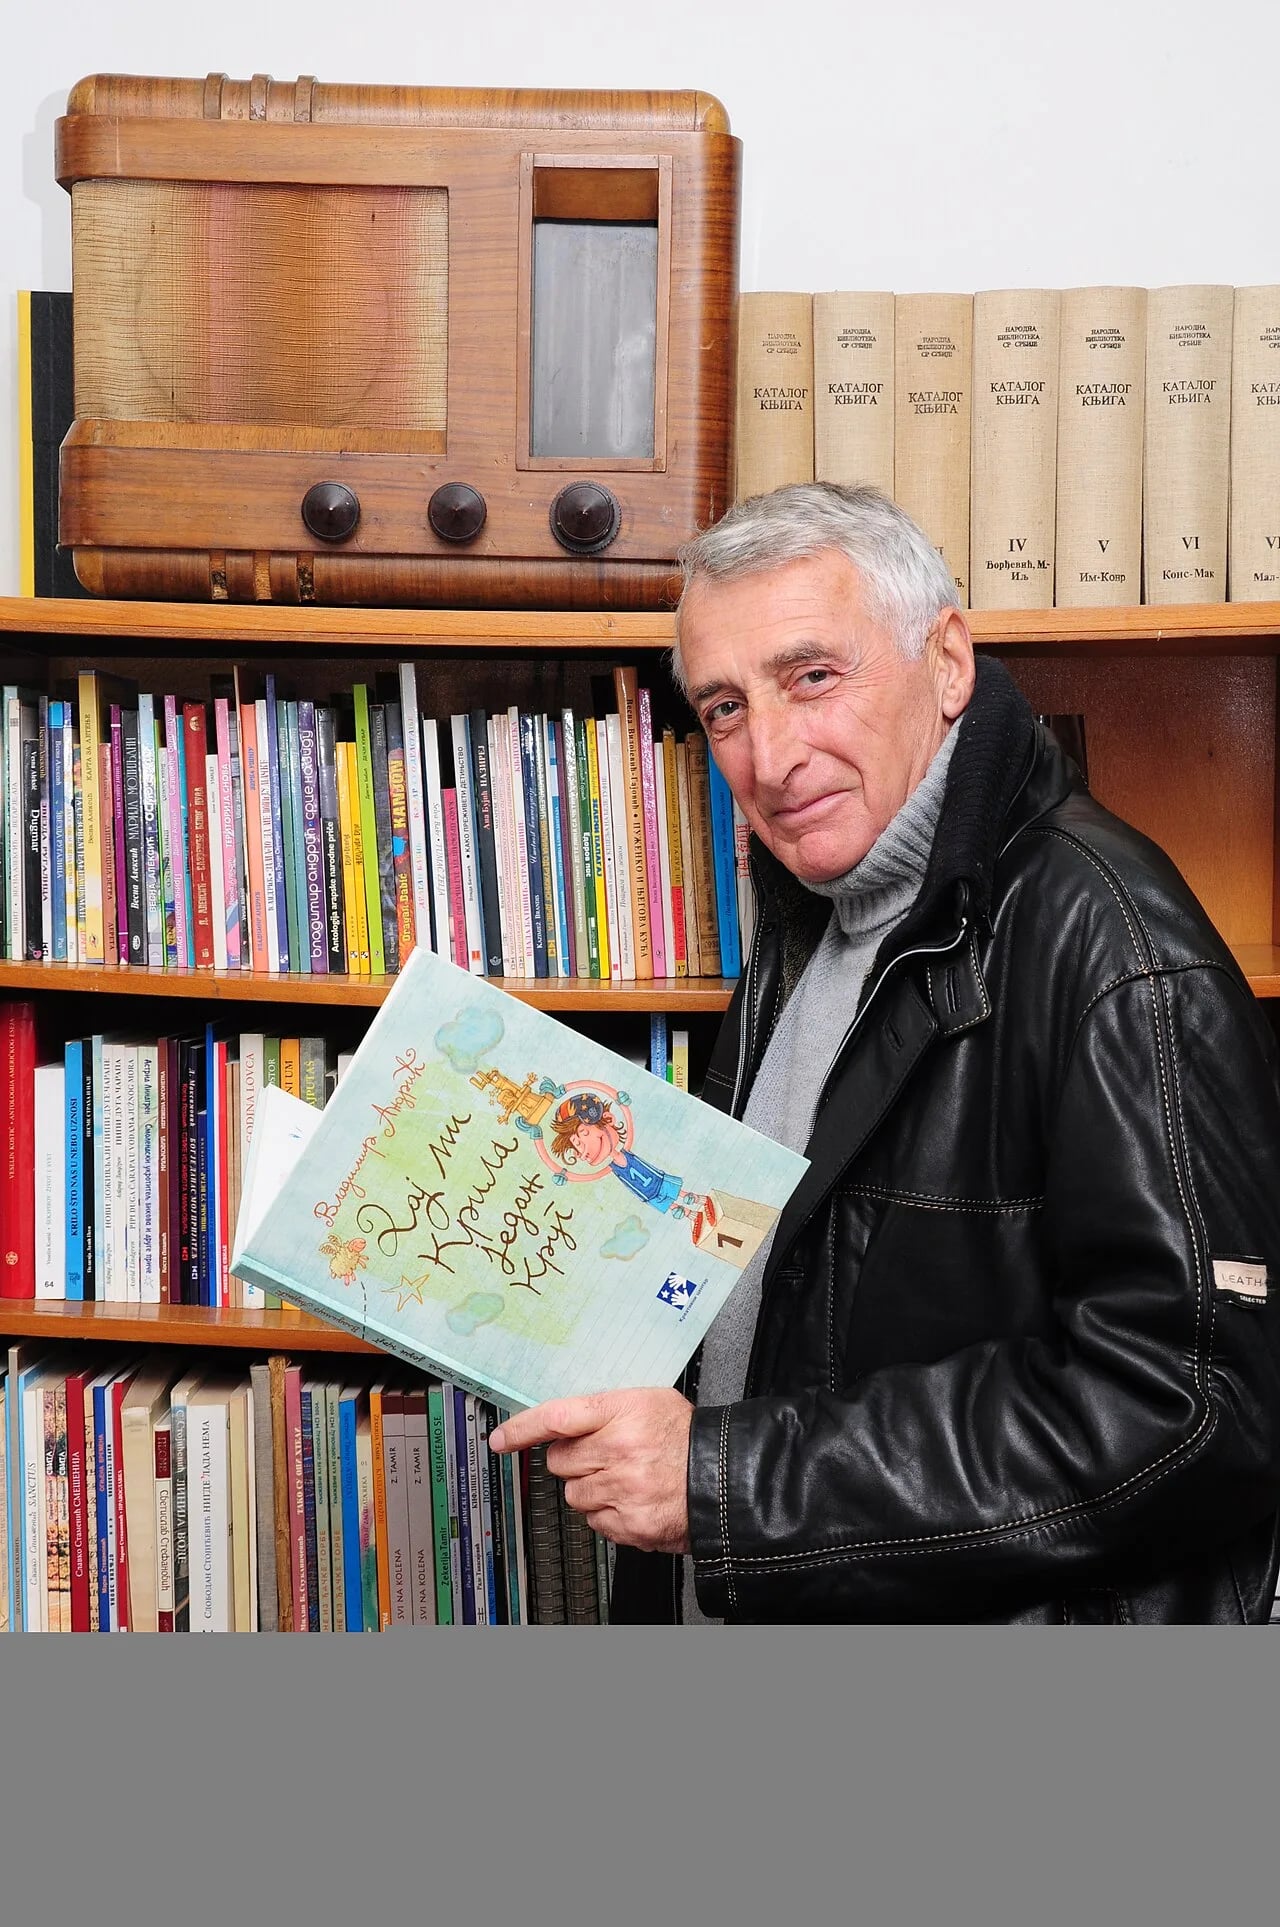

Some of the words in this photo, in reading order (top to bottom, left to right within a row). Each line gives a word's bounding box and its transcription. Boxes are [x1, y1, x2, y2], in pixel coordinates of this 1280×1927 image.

[754, 388, 808, 399] КАТАЛОГ
[828, 383, 883, 393] КАТАЛОГ
[834, 395, 877, 405] КЊИГА
[908, 392, 963, 402] КАТАЛОГ
[990, 382, 1045, 392] КАТАЛОГ
[996, 395, 1040, 405] КЊИГА
[1076, 384, 1131, 394] КАТАЛОГ
[1163, 381, 1216, 391] КАТАЛОГ
[1168, 394, 1211, 404] КЊИГА
[760, 401, 803, 410] КЊИГА
[915, 404, 957, 414] КЊИГА
[1082, 396, 1125, 406] КЊИГА
[1008, 539, 1026, 551] IV
[1098, 540, 1109, 552] V
[1182, 536, 1199, 549] VI
[1011, 571, 1029, 581] Иљ
[1163, 568, 1214, 580] Конс-Мак
[625, 700, 634, 724] Весна
[222, 764, 230, 792] СНОВА
[457, 747, 467, 788] ДЕТИЊСТВО
[478, 745, 487, 786] НАЗИРЕЈ
[627, 729, 639, 810] Видојевић-Гајовић
[305, 787, 317, 819] срце
[389, 760, 407, 829] KANJON
[482, 791, 490, 812] Бујић
[128, 800, 139, 840] МАРИЈА
[222, 796, 234, 848] ТЕРИТОРИЈА
[461, 790, 469, 832] ПРЕЖИВЕТИ
[592, 798, 600, 833] ЗЕЛЕНИ
[325, 822, 335, 842] priče
[306, 828, 318, 881] андрић
[327, 844, 337, 876] narodne
[594, 835, 602, 877] ПАПАГАЈ
[633, 823, 644, 873] ПУЖЕНКО
[131, 884, 139, 909] Весна
[329, 879, 338, 909] arapske
[399, 873, 409, 902] Babić
[309, 884, 323, 958] владимир
[637, 887, 647, 927] ЊЕГОВА
[331, 911, 340, 952] Antologija
[402, 906, 412, 942] Dragan
[639, 932, 649, 958] КУЋА
[143, 1059, 152, 1082] Астрид
[246, 1053, 255, 1091] LOVCA
[285, 1060, 294, 1078] UM
[127, 1085, 135, 1116] JUŽNOG
[143, 1085, 152, 1114] Линдгрен
[314, 1136, 387, 1227] Владимир
[371, 1048, 425, 1137] Андрић
[429, 1114, 472, 1179] ми
[182, 1154, 188, 1163] ИЗ
[190, 1154, 196, 1165] ЈЕ
[127, 1158, 136, 1190] ČARAPA
[144, 1165, 152, 1200] укротитељ
[629, 1166, 653, 1187] 1
[718, 1233, 743, 1249] 1
[201, 1421, 210, 1449] НЕМА
[434, 1416, 441, 1425] SE
[157, 1437, 166, 1472] ПЕСМЕ
[413, 1448, 421, 1474] TAMIR
[434, 1428, 444, 1482] SMEJAĆEMO
[28, 1463, 36, 1506] SANCTUS
[72, 1452, 81, 1506] СМЕШЕНИЈА
[296, 1478, 302, 1489] СУ
[391, 1476, 397, 1484] Z.
[414, 1476, 421, 1484] Z.
[176, 1479, 186, 1526] ЛИНИЈА
[202, 1480, 212, 1513] НИГДЕ
[160, 1490, 169, 1535] Светислав
[73, 1508, 82, 1547] Стаменић
[176, 1532, 186, 1563] ВОДЕ
[75, 1549, 83, 1577] Славко
[160, 1538, 169, 1591] Стефановић
[394, 1549, 403, 1585] KOLENA
[440, 1553, 450, 1586] Zekerija
[204, 1573, 212, 1618] СЛОБОДАН
[321, 1565, 329, 1598] ЂАЧКЕ
[335, 1565, 343, 1598] ЂАЧКЕ
[395, 1588, 404, 1603] NA
[419, 1589, 426, 1603] NA
[396, 1605, 404, 1620] SVI
